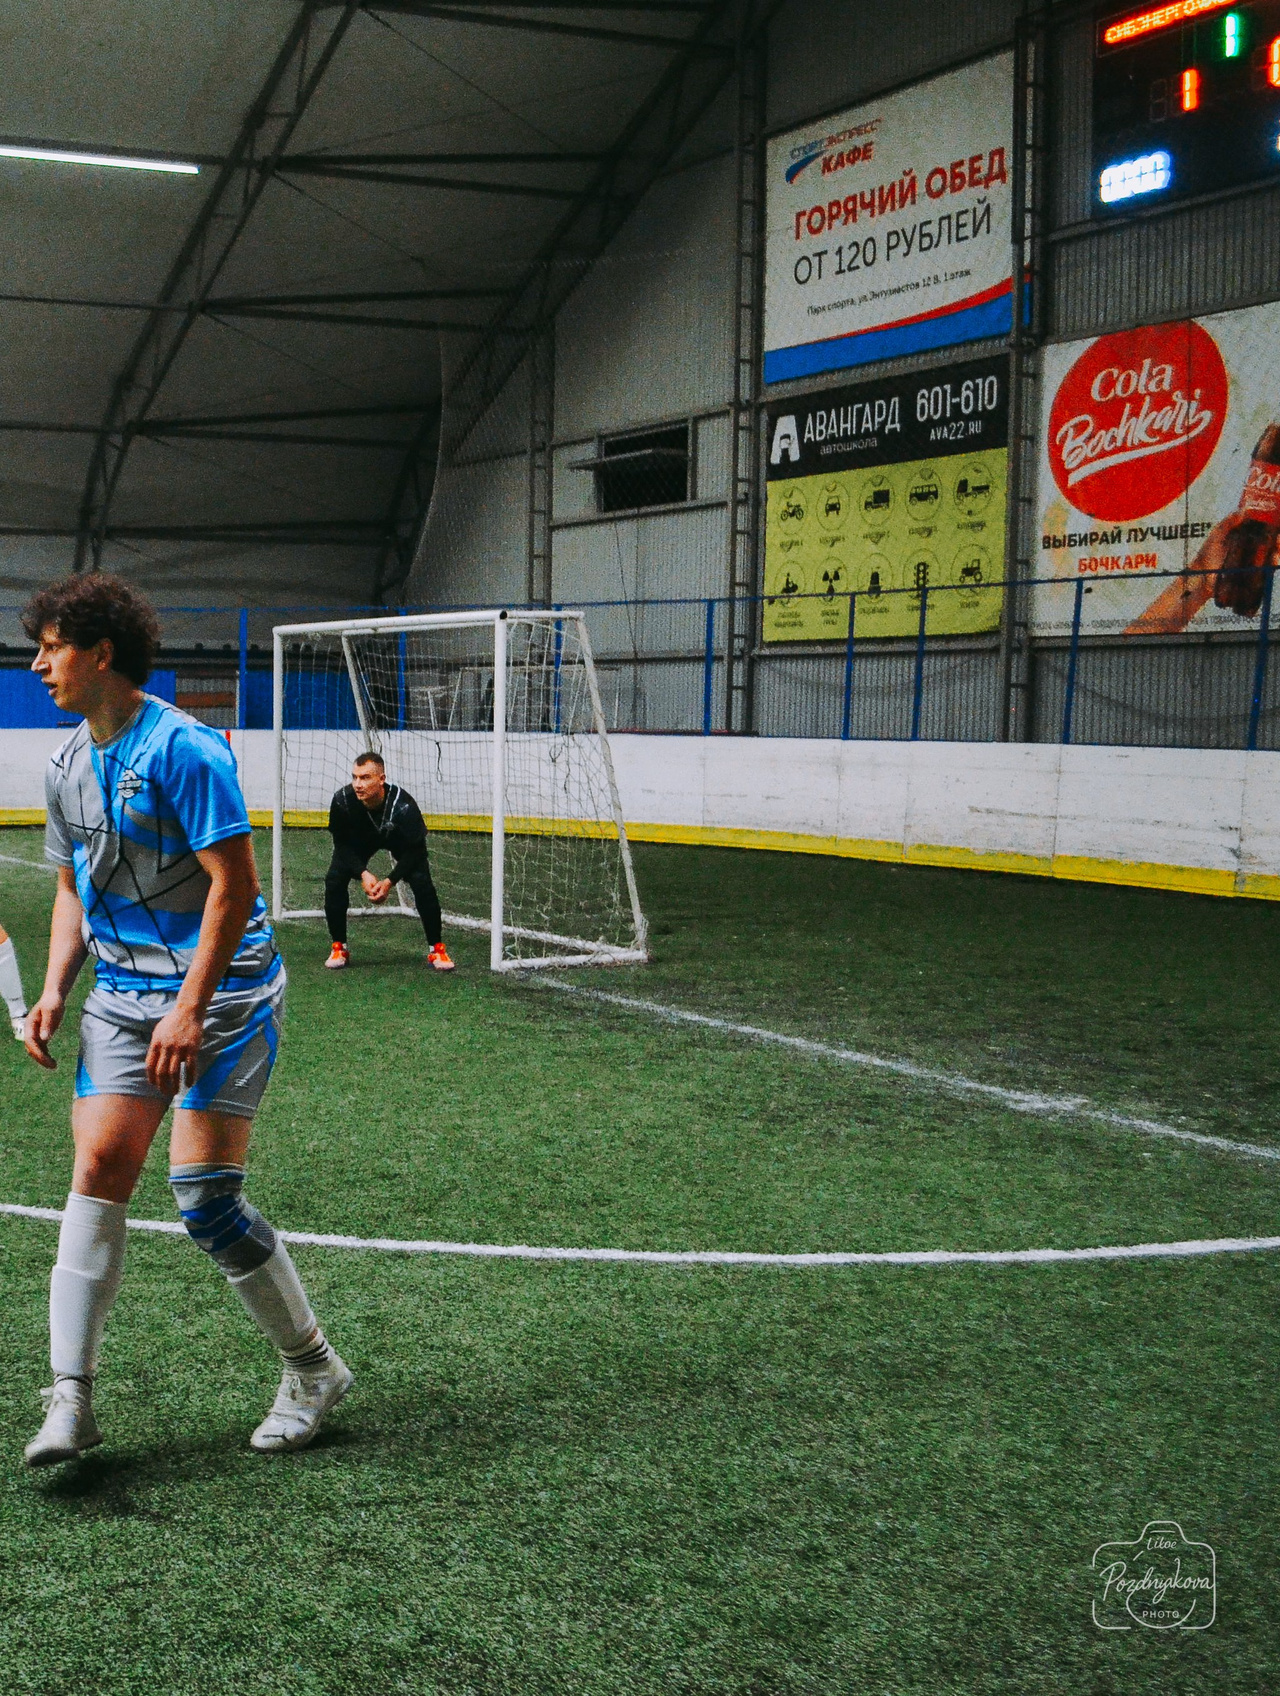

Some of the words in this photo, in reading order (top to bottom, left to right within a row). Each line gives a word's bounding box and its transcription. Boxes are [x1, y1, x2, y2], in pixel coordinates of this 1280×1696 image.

[821, 140, 874, 177] КАФЕ
[794, 168, 917, 241] ГОРЯЧИЙ
[924, 146, 1008, 201] ОБЕД
[793, 250, 826, 285] ОТ
[834, 236, 877, 276] 120
[885, 197, 993, 262] РУБЛЕЙ
[916, 375, 998, 423] 601-610
[1091, 358, 1173, 402] Cola
[803, 396, 901, 444] АВАНГАРД
[929, 420, 982, 442] AVA22.RU
[1056, 389, 1214, 487] Bochkari
[820, 436, 878, 456] автошкола
[1042, 525, 1122, 550] ВЫБИРАЙ
[1078, 552, 1158, 574] БОЧКАРИ
